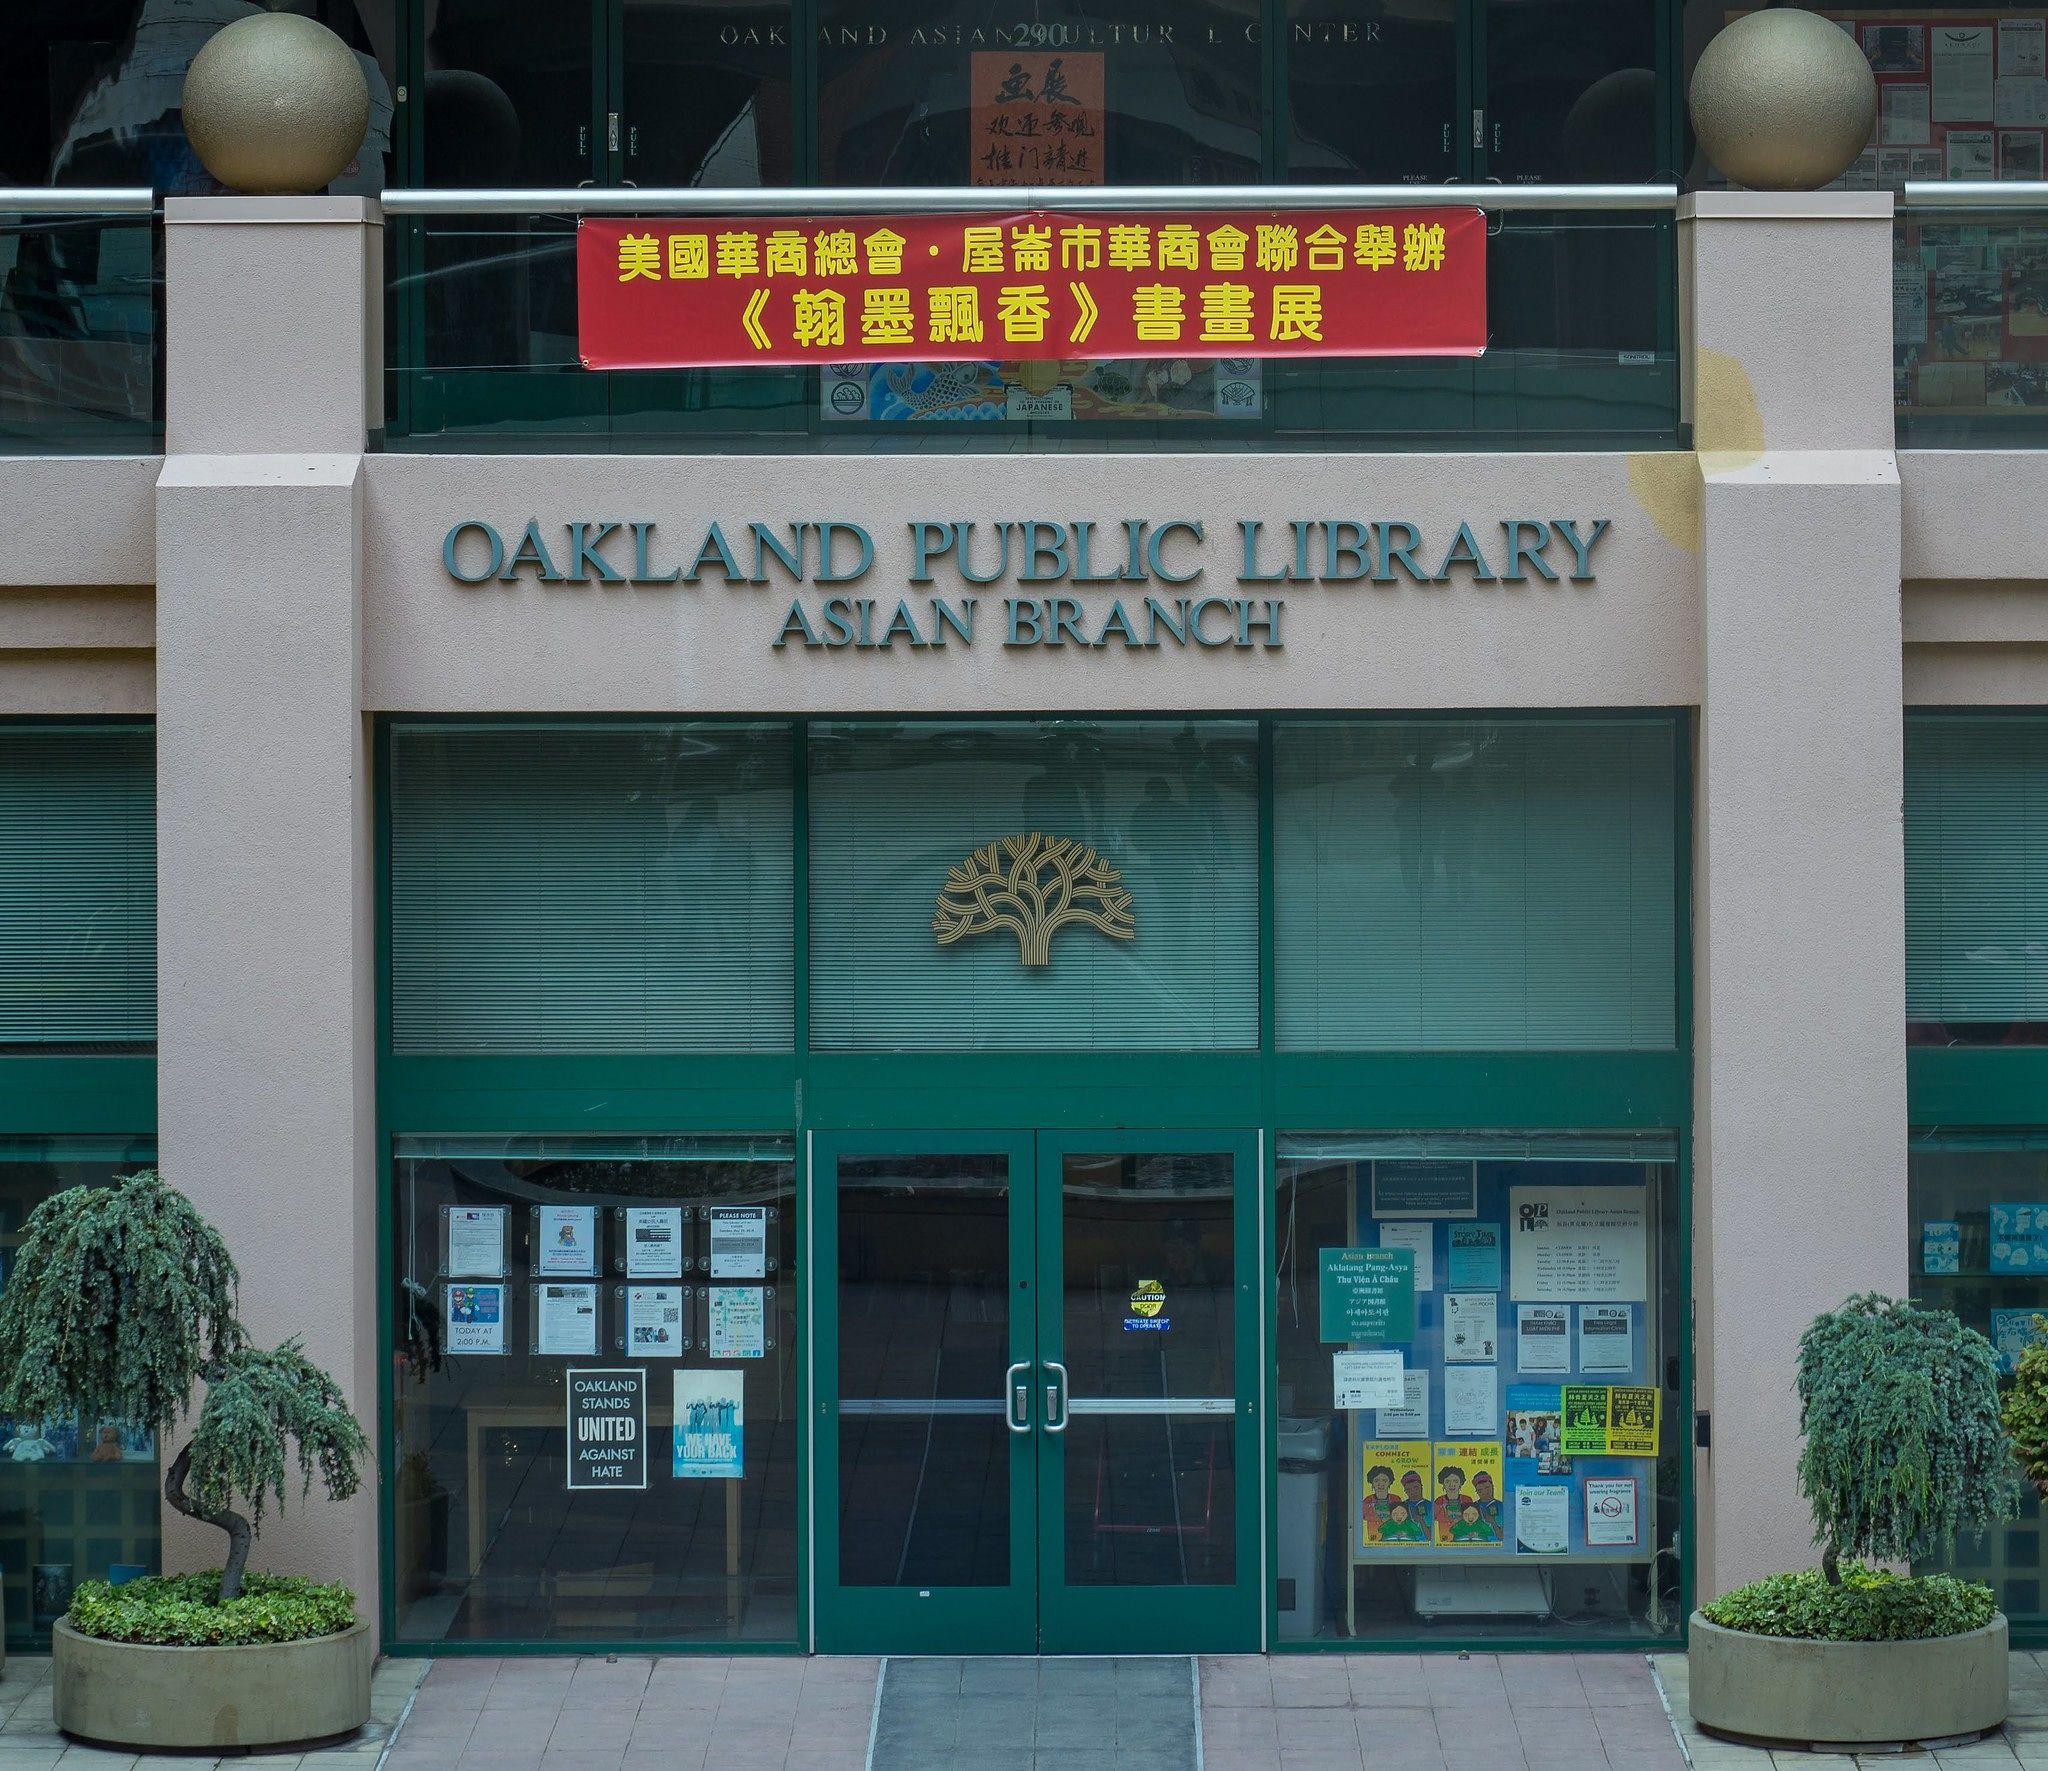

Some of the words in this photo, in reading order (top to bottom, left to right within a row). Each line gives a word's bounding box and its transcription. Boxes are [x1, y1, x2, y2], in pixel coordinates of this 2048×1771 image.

[720, 24, 888, 45] OAKAND
[1245, 22, 1382, 43] CNTER
[1013, 22, 1064, 47] 290
[579, 126, 587, 156] PULL
[630, 126, 638, 156] PULL
[1443, 123, 1451, 152] PULL
[1494, 123, 1502, 152] PULL
[1016, 403, 1063, 411] JAPANESE
[442, 518, 876, 585] OAKLAND
[908, 518, 1205, 583] PUBLIC
[1236, 518, 1612, 583] LIBRARY
[771, 597, 978, 648] ASIAN
[1003, 596, 1285, 648] BRANCH
[1366, 1252, 1394, 1260] Branch
[1327, 1264, 1364, 1273] Aklatang
[1365, 1264, 1408, 1273] Pang-Asya
[455, 1327, 481, 1335] TODAY
[483, 1327, 494, 1335] AT
[574, 1380, 637, 1393] OAKLAND
[582, 1397, 631, 1409] STANDS
[578, 1416, 636, 1441] UNITED
[579, 1448, 636, 1460] AGAINST
[677, 1445, 705, 1458] YOUR
[708, 1445, 737, 1458] BACK
[592, 1465, 623, 1478] HATE
